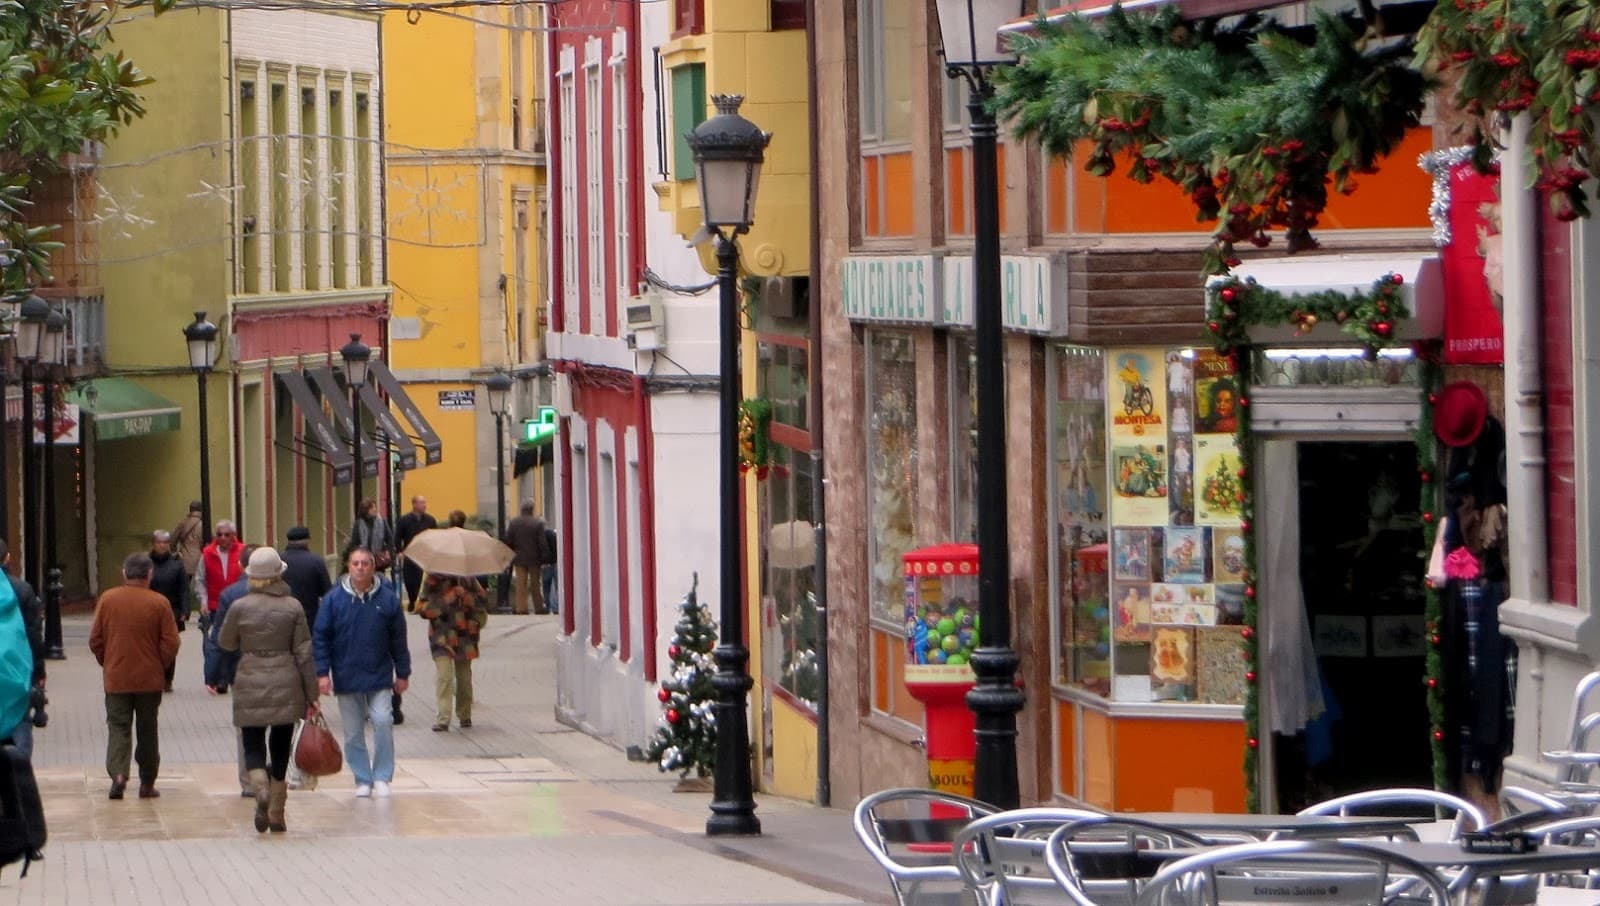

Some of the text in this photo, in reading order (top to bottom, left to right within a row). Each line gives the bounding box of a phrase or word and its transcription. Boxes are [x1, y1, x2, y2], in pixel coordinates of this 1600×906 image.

[842, 260, 1044, 326] NOVEDADES LA RLA
[1449, 338, 1501, 352] PROSPERO
[1114, 415, 1162, 425] MONTESA
